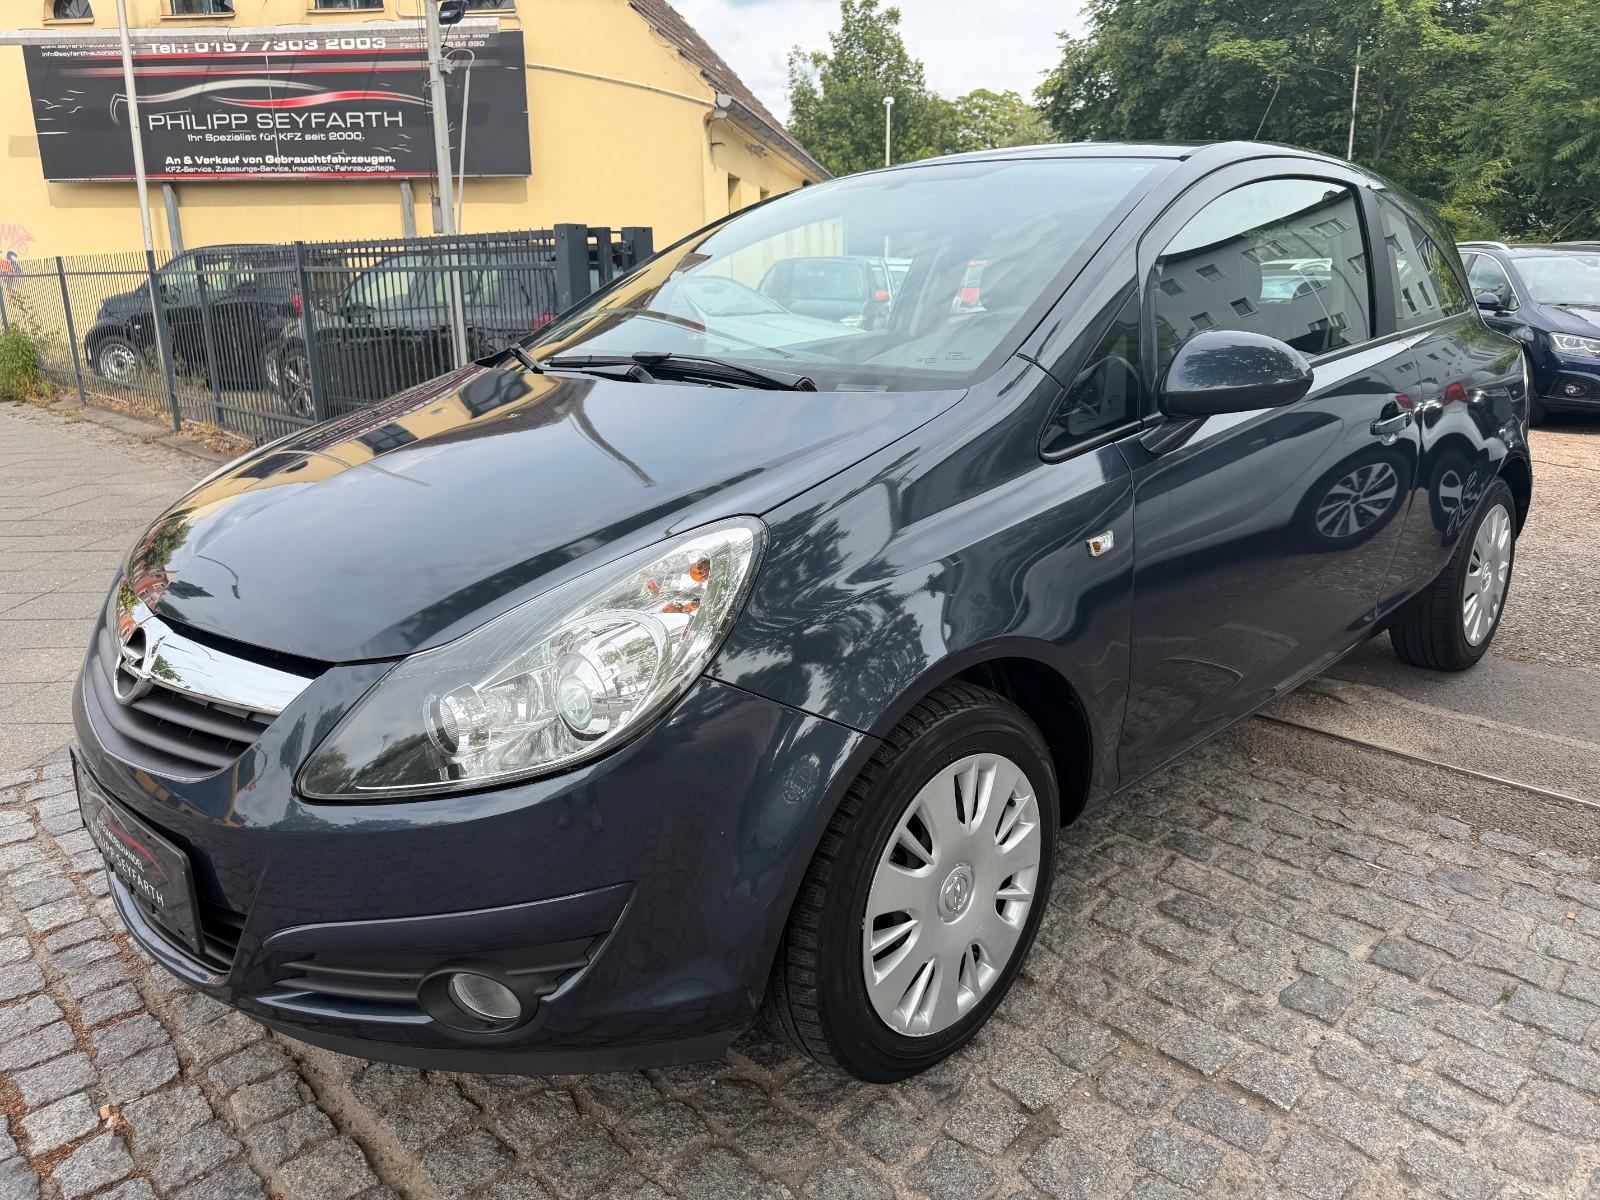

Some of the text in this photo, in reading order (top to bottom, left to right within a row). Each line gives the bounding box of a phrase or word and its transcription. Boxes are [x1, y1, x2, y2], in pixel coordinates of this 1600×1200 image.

[147, 38, 386, 54] Tel.: 0157 7303 2003
[148, 111, 404, 130] PHILIPP SEYFARTH
[187, 131, 366, 143] Ihr Spezialist für KFZ seit 2000.
[165, 154, 396, 165] An & Verkauf von Gebrauchtfahrzeugen.
[165, 165, 214, 173] KFZ-Service,
[215, 164, 291, 174] Zulassungs-Service,
[292, 164, 334, 173] Inspektion,
[116, 853, 164, 907] SEYFARTH
